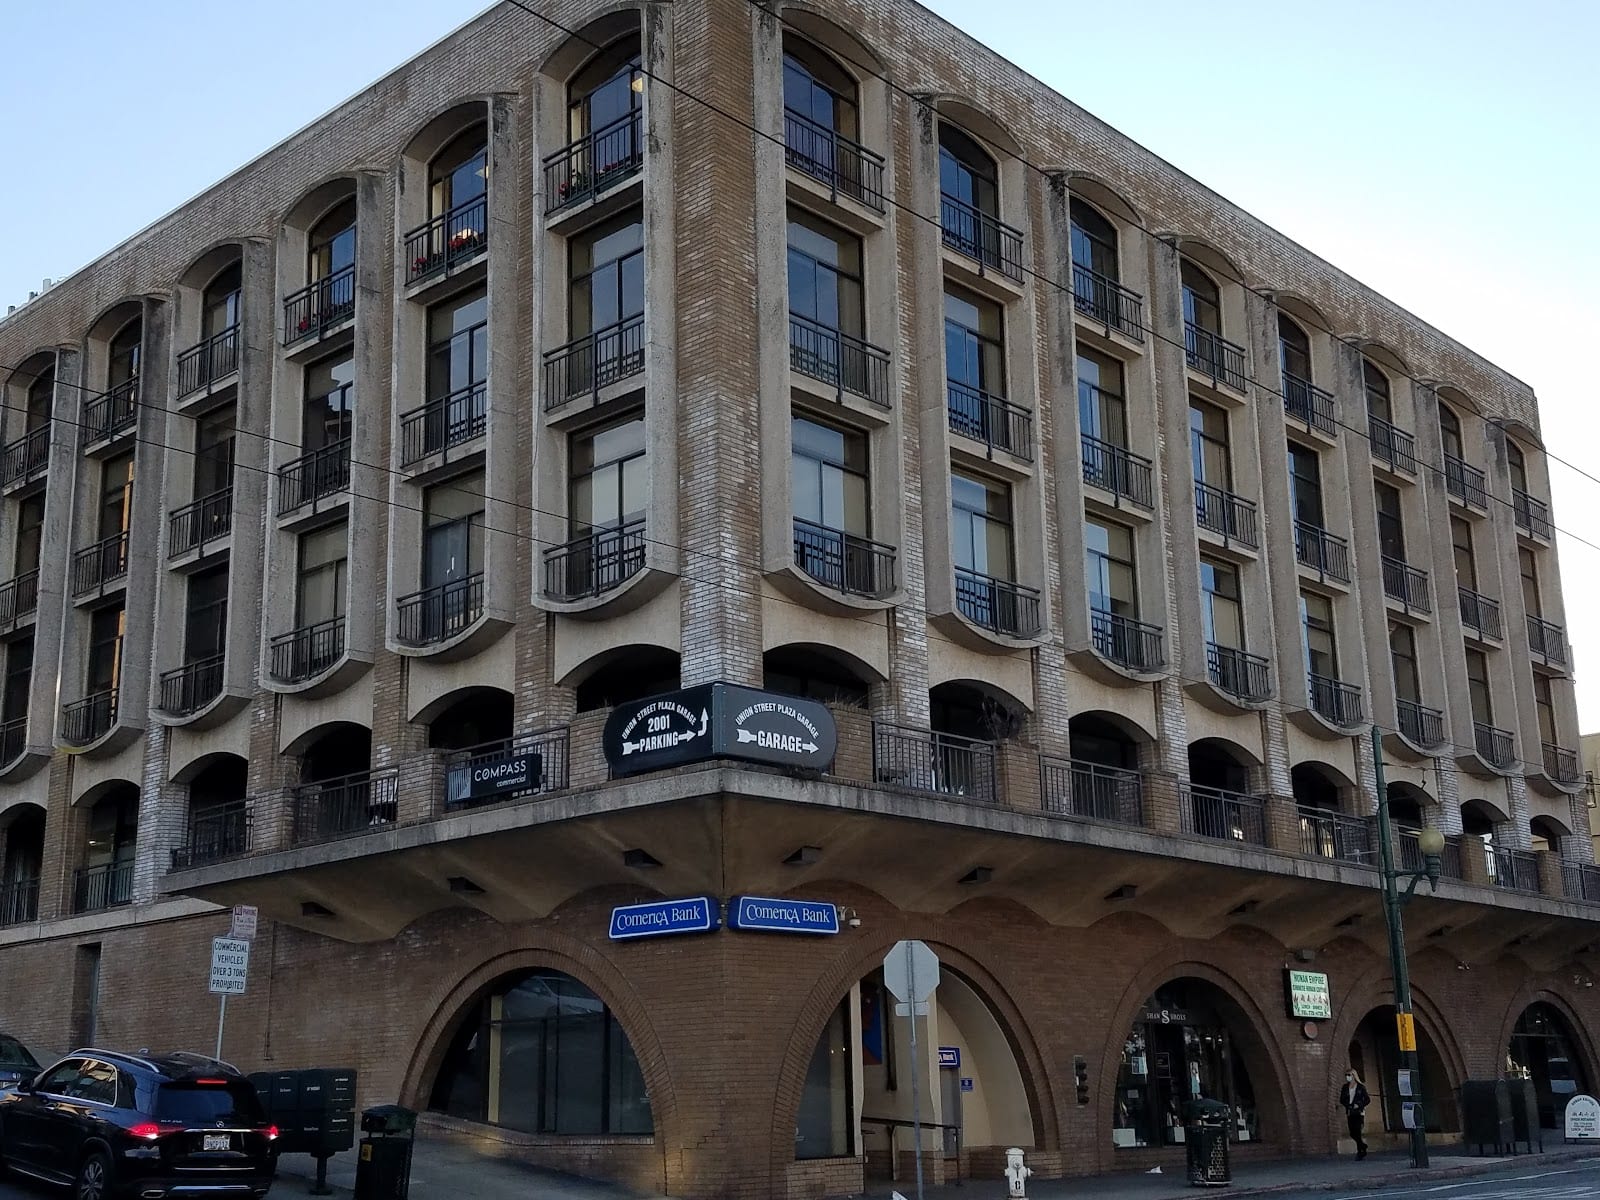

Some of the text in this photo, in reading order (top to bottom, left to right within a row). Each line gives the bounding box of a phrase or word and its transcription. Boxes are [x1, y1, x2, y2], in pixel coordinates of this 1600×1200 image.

[622, 701, 696, 740] UNION STREET PLAZA GARAGE
[647, 714, 670, 733] 2001
[735, 702, 819, 739] UNION STREET PLAZA GARAGE
[640, 731, 678, 752] PARKING
[757, 730, 802, 753] GARAGE
[474, 760, 527, 782] COMPASS
[496, 774, 527, 787] commercial
[672, 905, 701, 921] Bank
[802, 908, 830, 923] Bank
[214, 941, 248, 953] COMMERCIAL
[217, 955, 244, 965] VEHICLES
[212, 966, 246, 977] OVER 3 TONS
[211, 979, 244, 990] PROHIBITED
